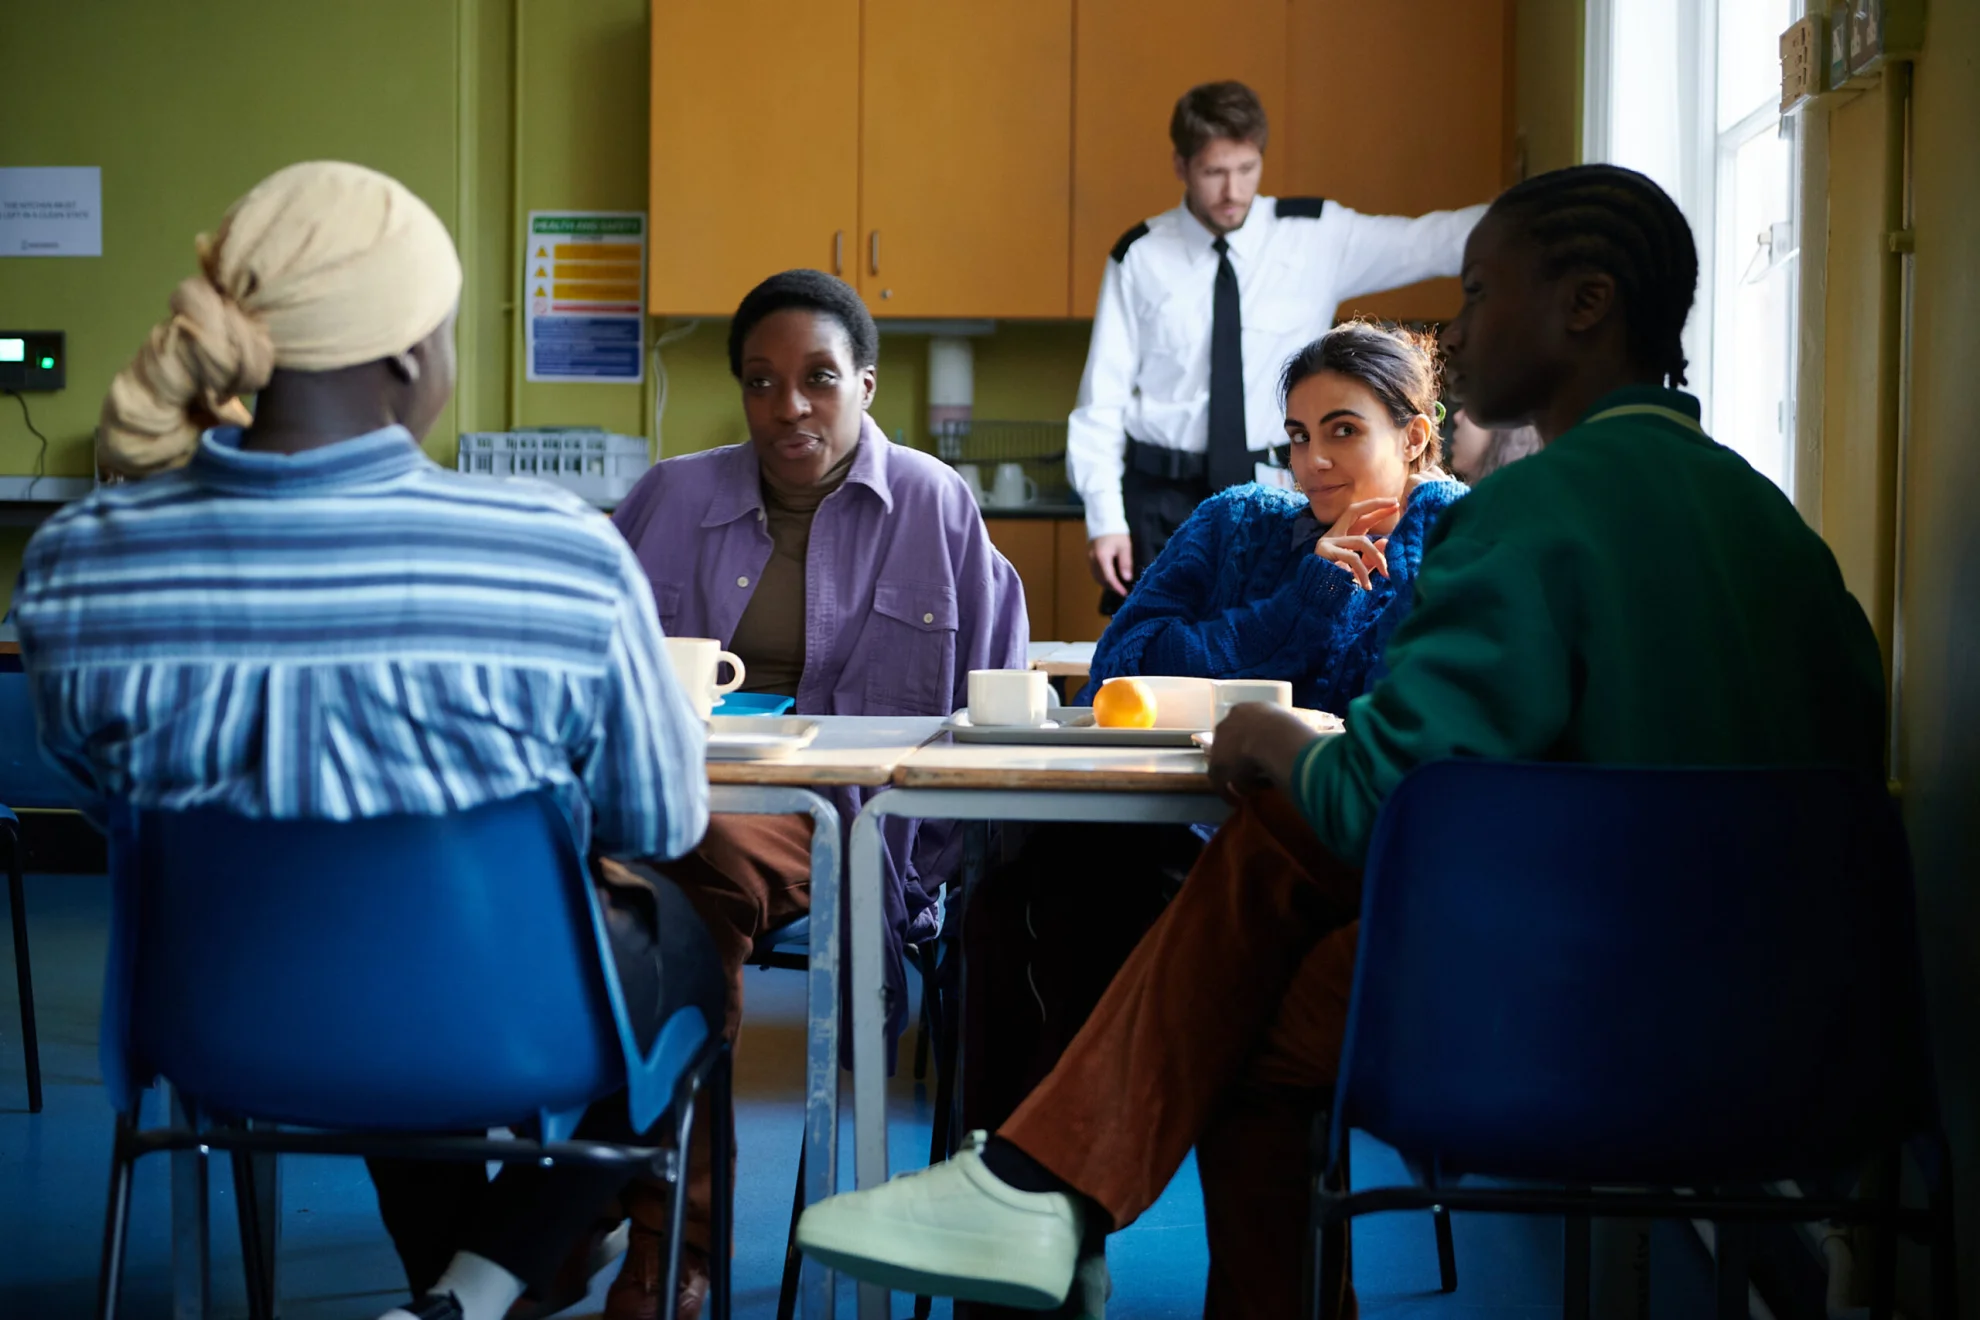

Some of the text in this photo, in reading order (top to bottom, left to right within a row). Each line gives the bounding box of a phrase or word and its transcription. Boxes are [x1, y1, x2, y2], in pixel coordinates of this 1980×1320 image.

[535, 221, 638, 230] HEALTH AND SAFETY
